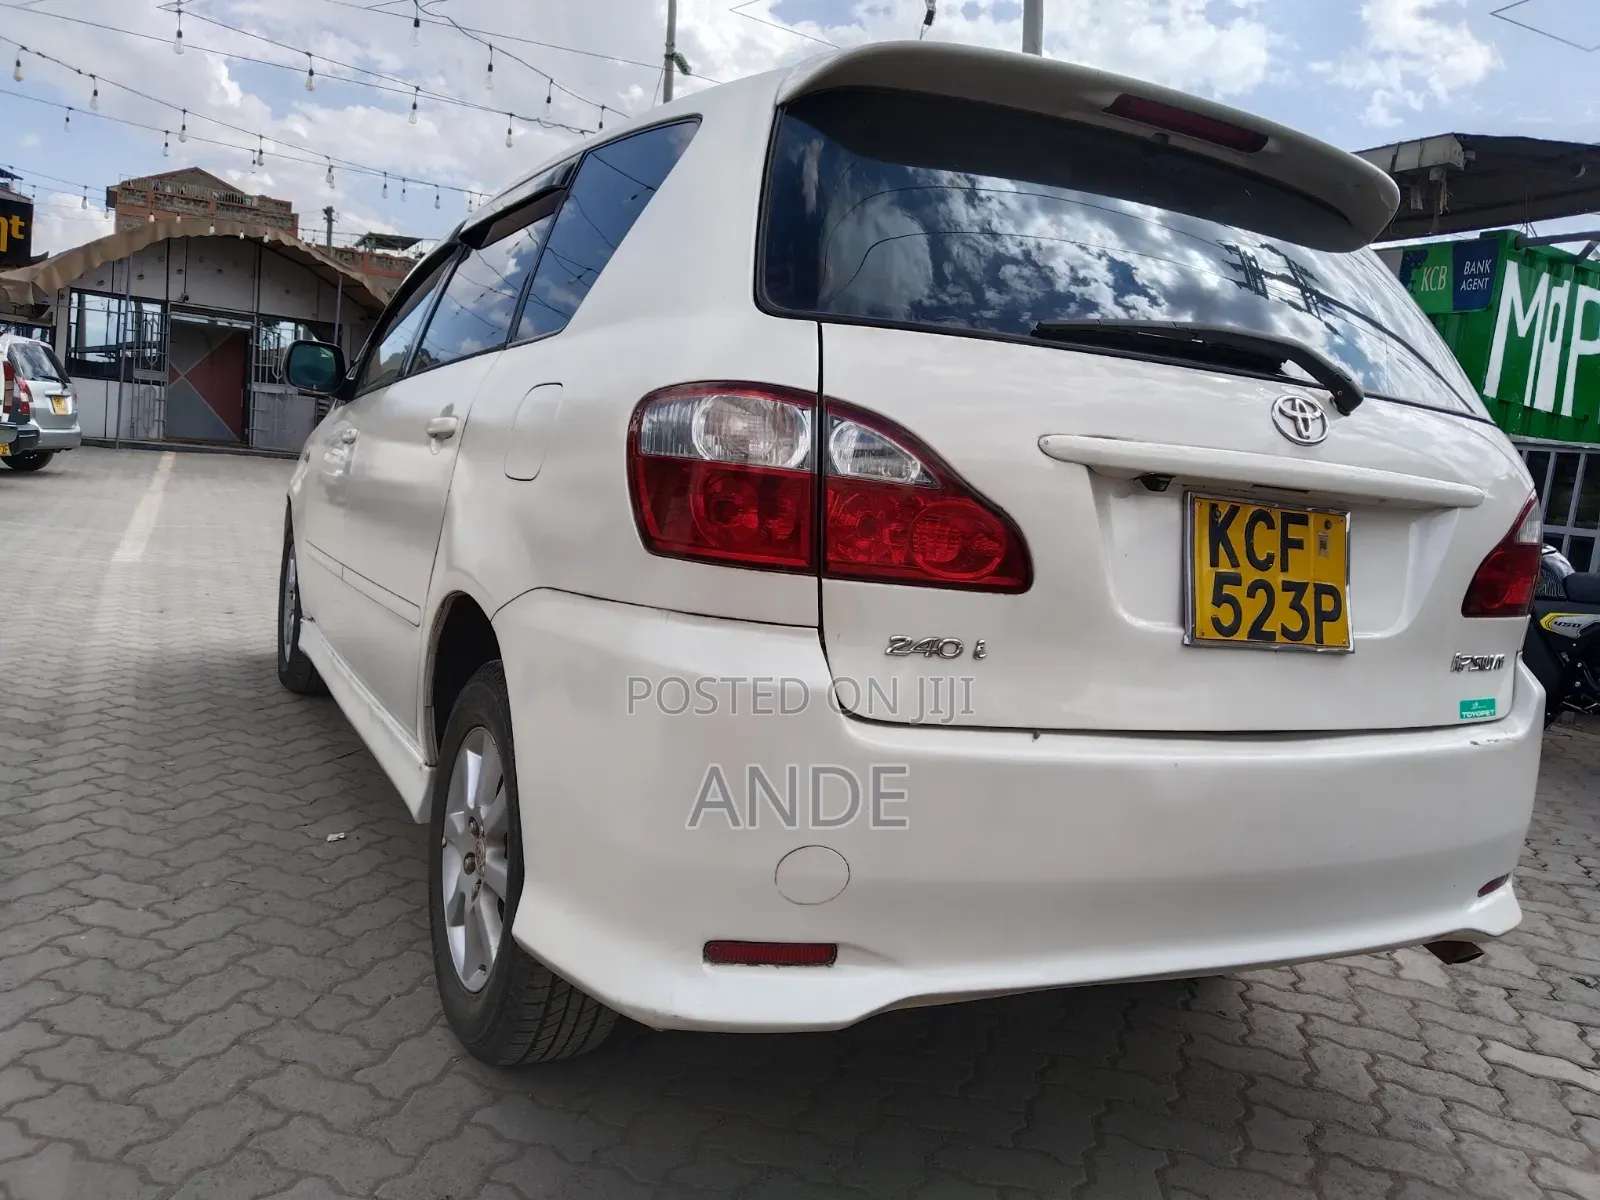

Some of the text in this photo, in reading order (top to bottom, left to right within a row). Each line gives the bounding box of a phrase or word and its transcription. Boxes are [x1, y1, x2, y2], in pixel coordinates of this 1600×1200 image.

[1421, 265, 1448, 291] KCB
[1463, 259, 1492, 275] BANK
[1460, 278, 1489, 291] AGENT
[1208, 503, 1309, 572] KCF
[1210, 571, 1342, 644] 523P
[885, 635, 964, 659] 240
[1461, 709, 1495, 718] TOYOPET
